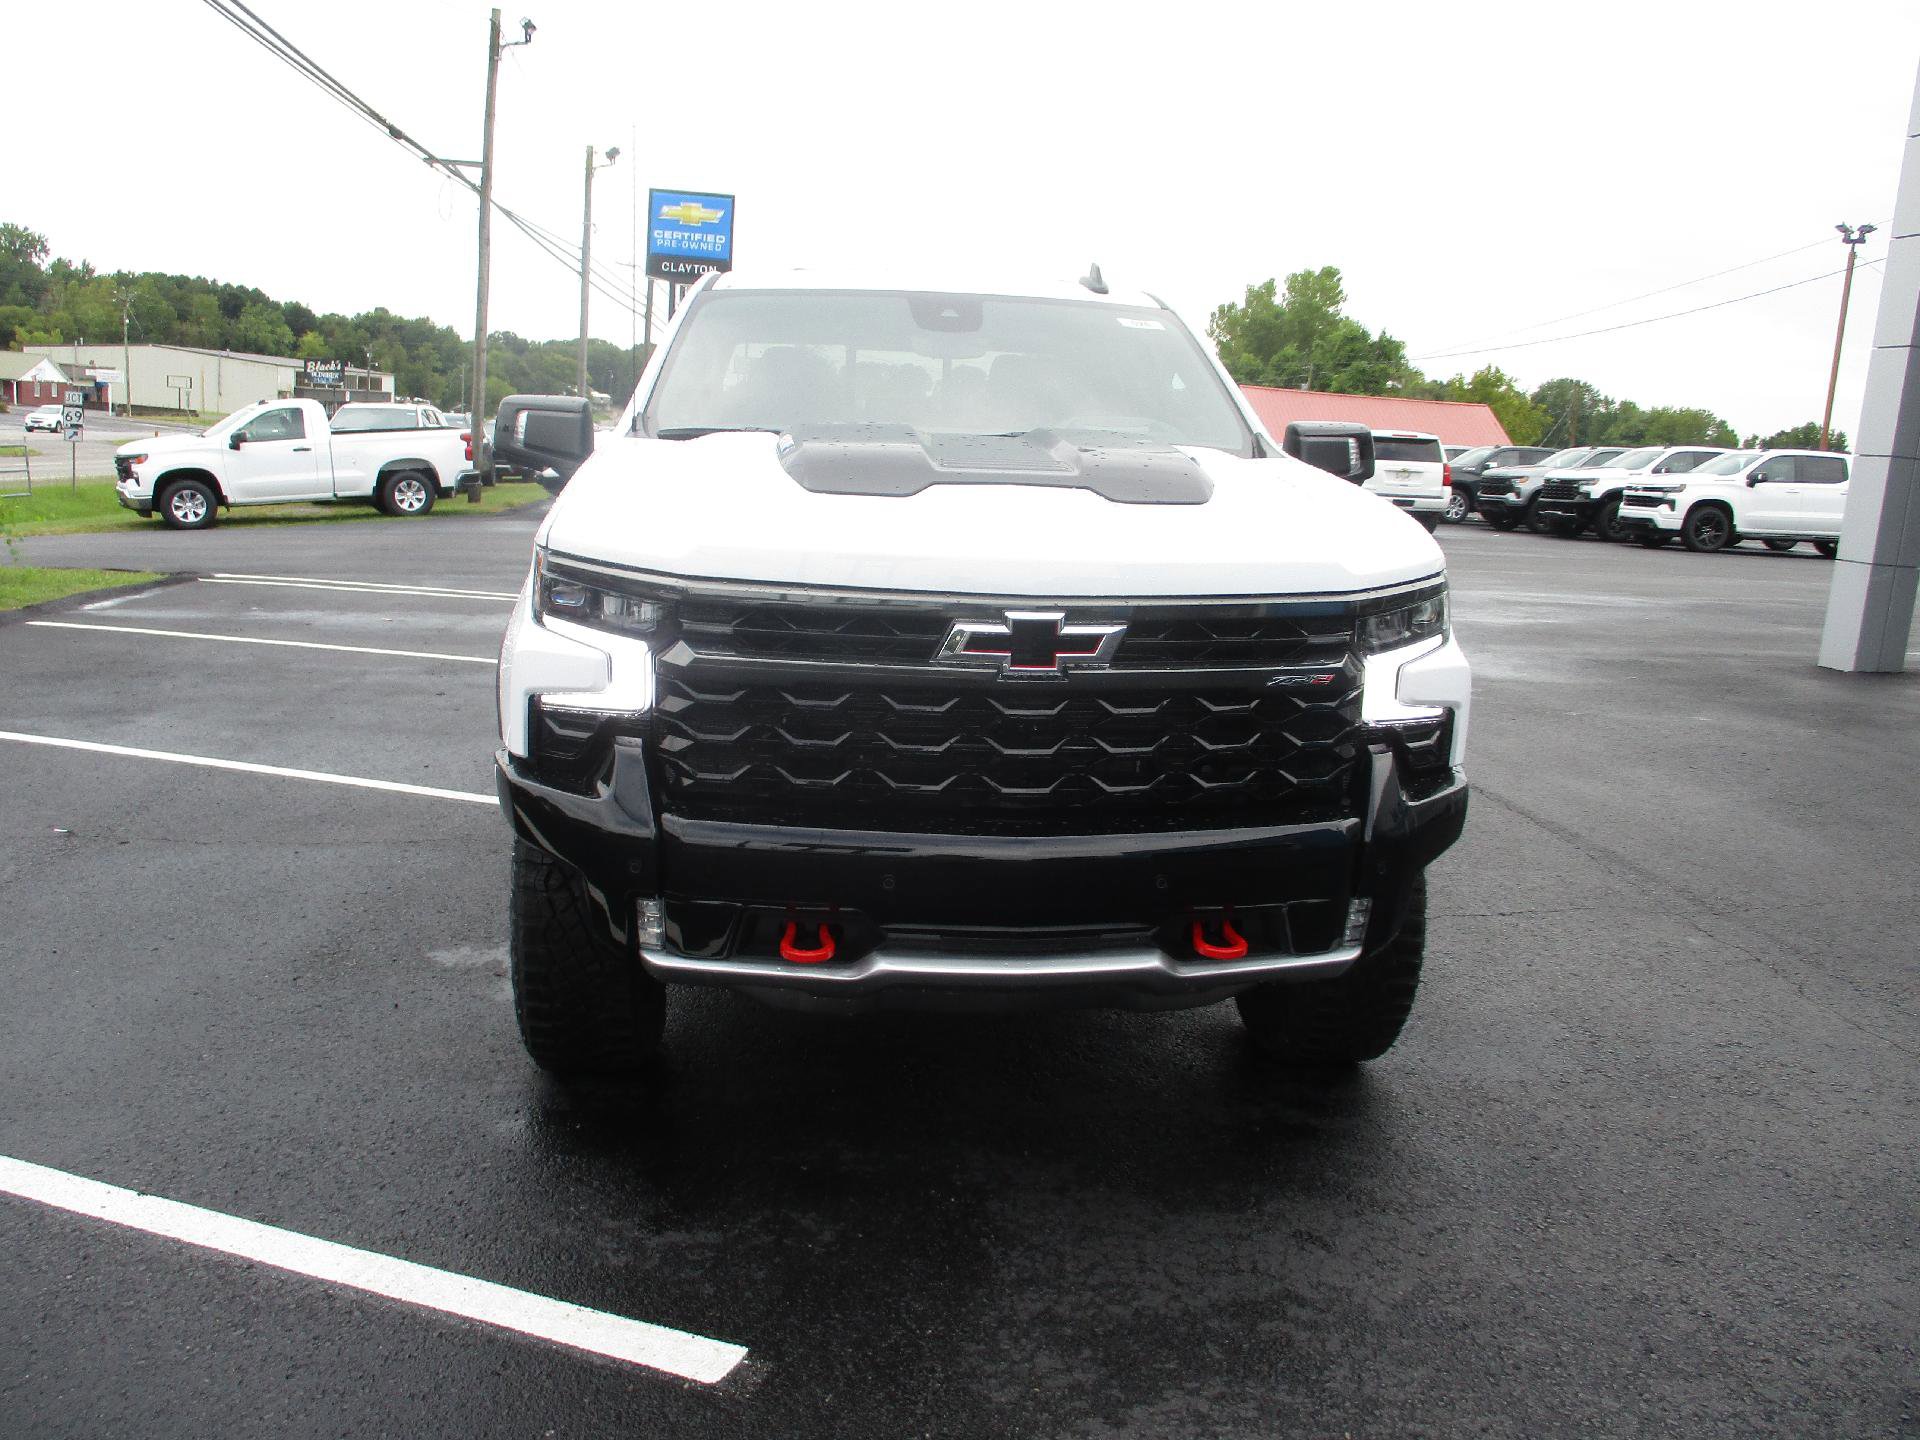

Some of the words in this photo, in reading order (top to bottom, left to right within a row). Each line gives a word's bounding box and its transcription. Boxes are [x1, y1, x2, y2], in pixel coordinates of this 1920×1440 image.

[654, 230, 726, 244] CERTIFIED
[656, 239, 722, 252] PRE-OWNED
[661, 261, 717, 274] CLAYTON
[66, 392, 81, 403] JCT
[65, 410, 82, 422] 69
